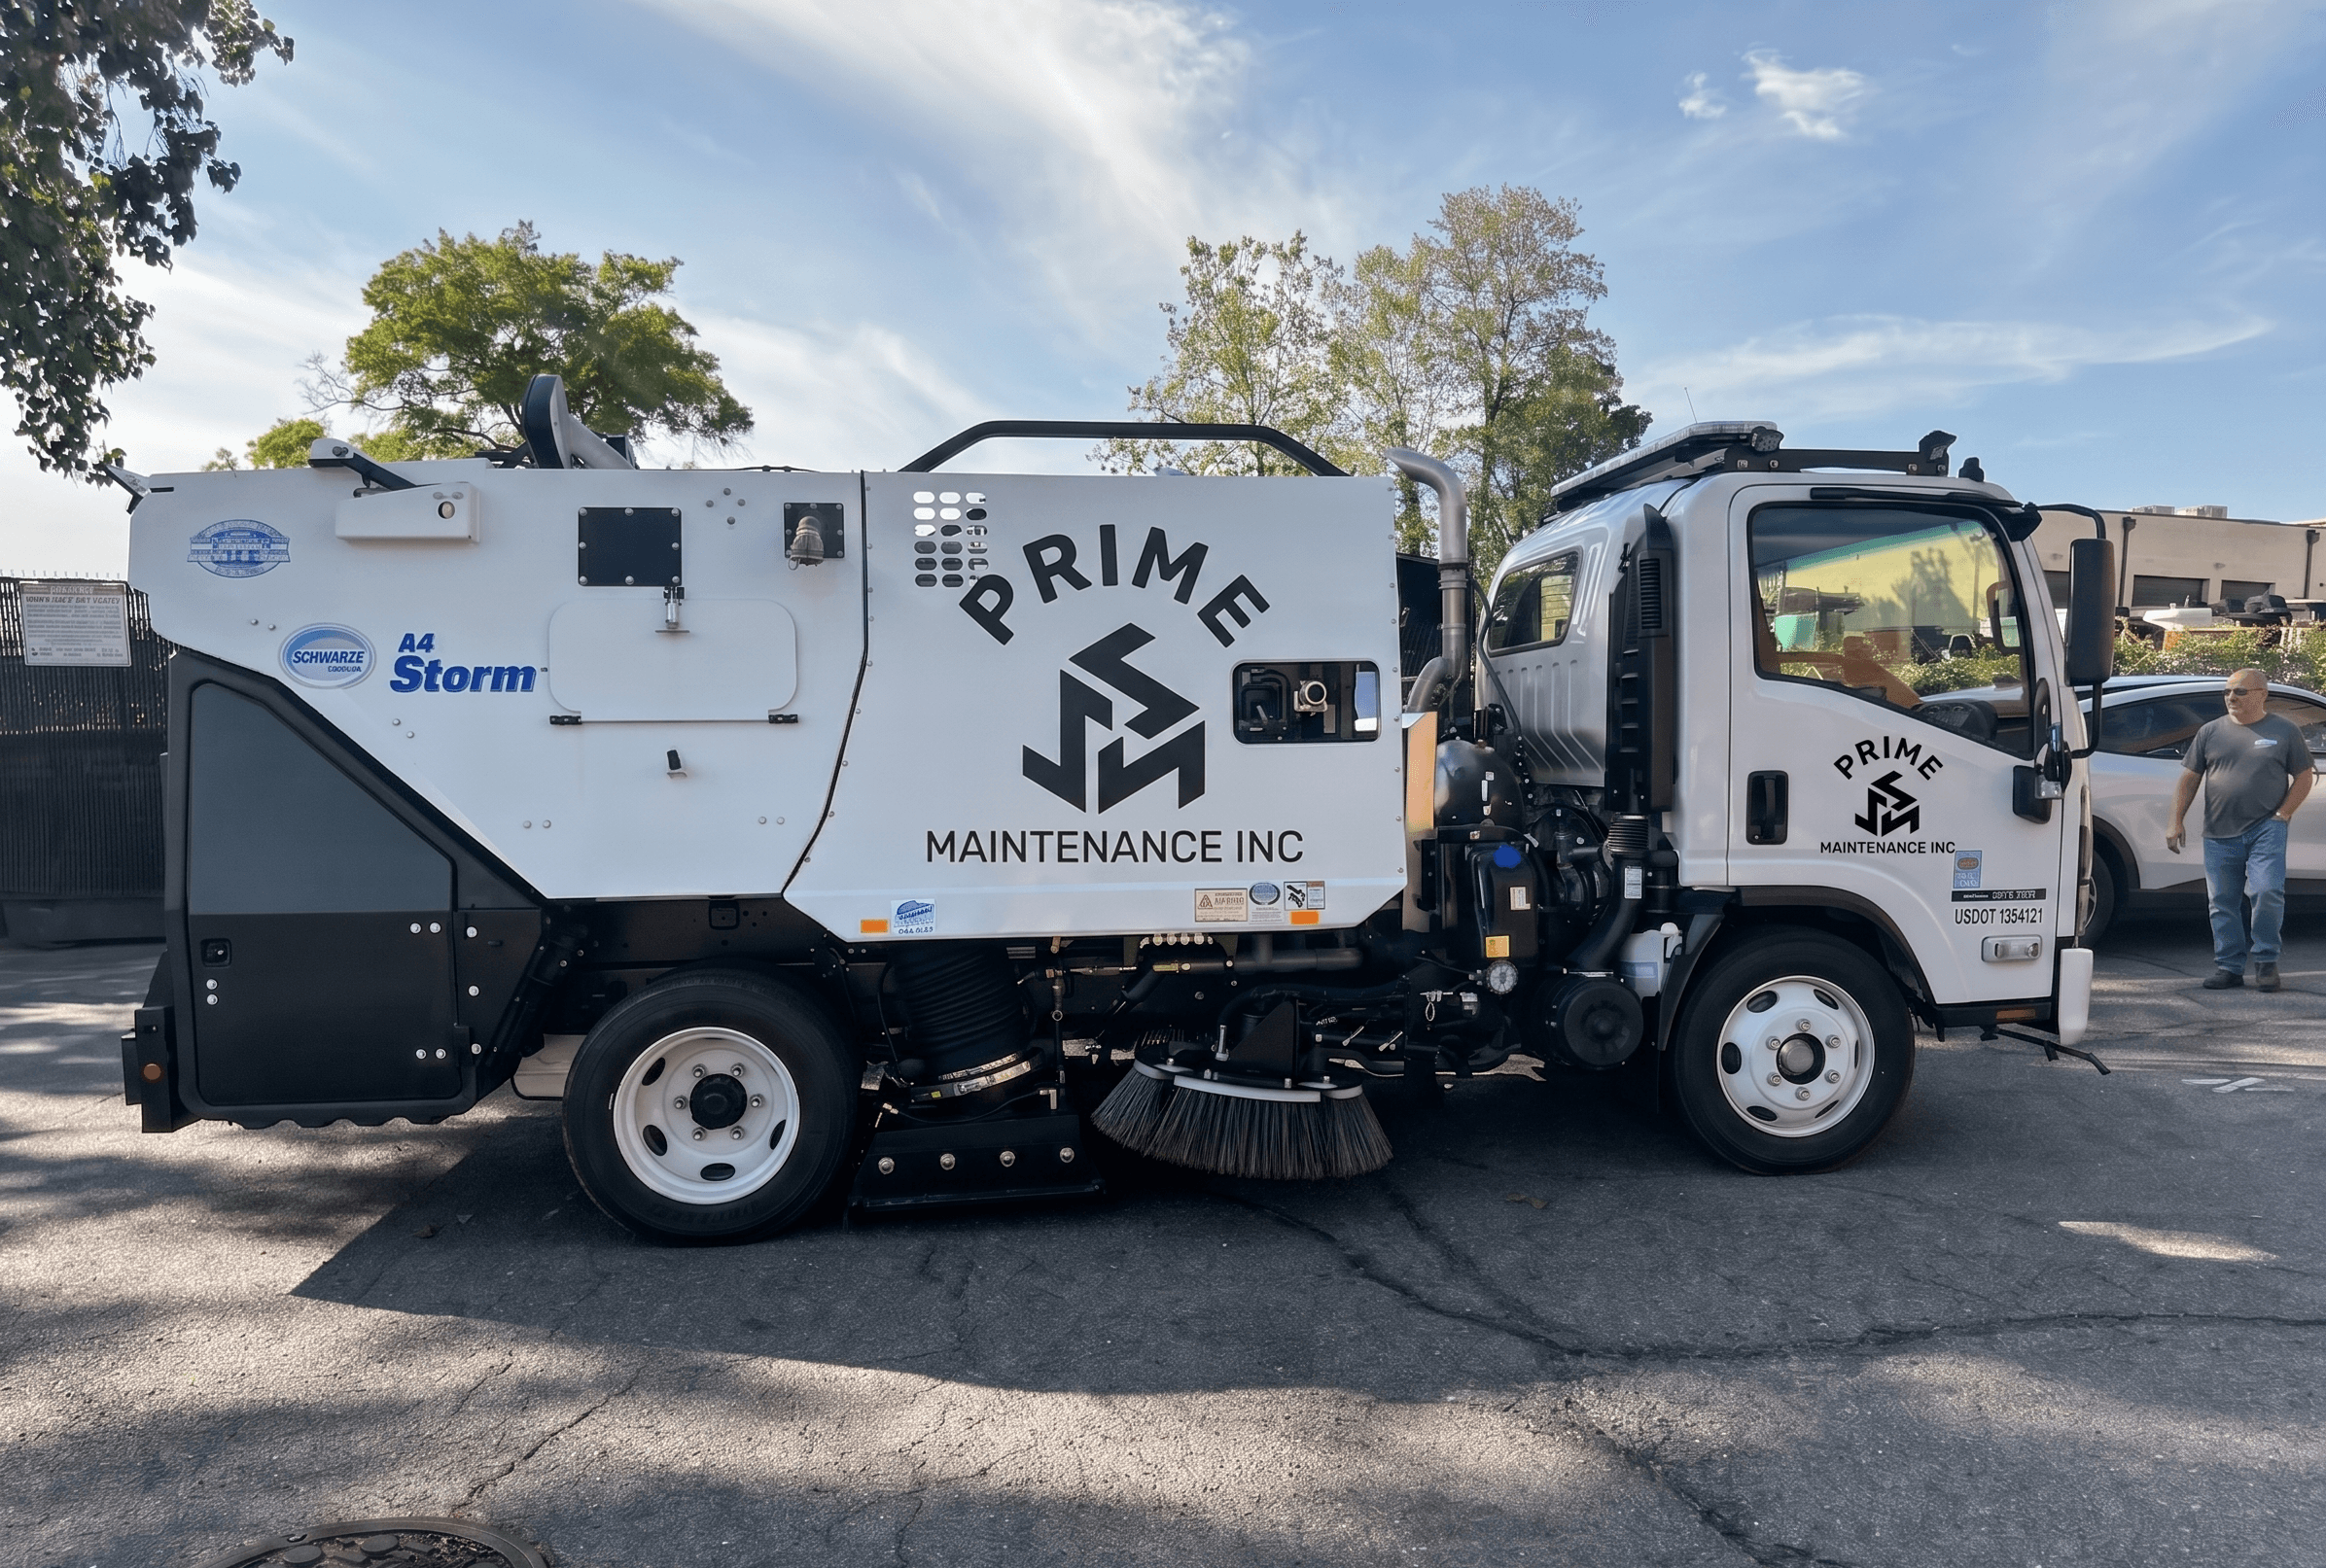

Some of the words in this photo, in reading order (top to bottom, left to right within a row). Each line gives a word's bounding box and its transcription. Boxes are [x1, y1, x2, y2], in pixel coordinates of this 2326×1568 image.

[958, 523, 1272, 647] PRIME
[292, 649, 366, 665] SCHWARZE
[398, 632, 437, 654] A4
[388, 654, 538, 694] Storm
[1833, 735, 1944, 782] PRIME
[926, 829, 1223, 864] MAINTENANCE
[1236, 829, 1304, 864] INC
[1820, 841, 1927, 854] MAINTENANCE
[1930, 841, 1956, 854] INC
[1955, 907, 1998, 925] USDOT
[1999, 907, 2044, 924] 1354121
